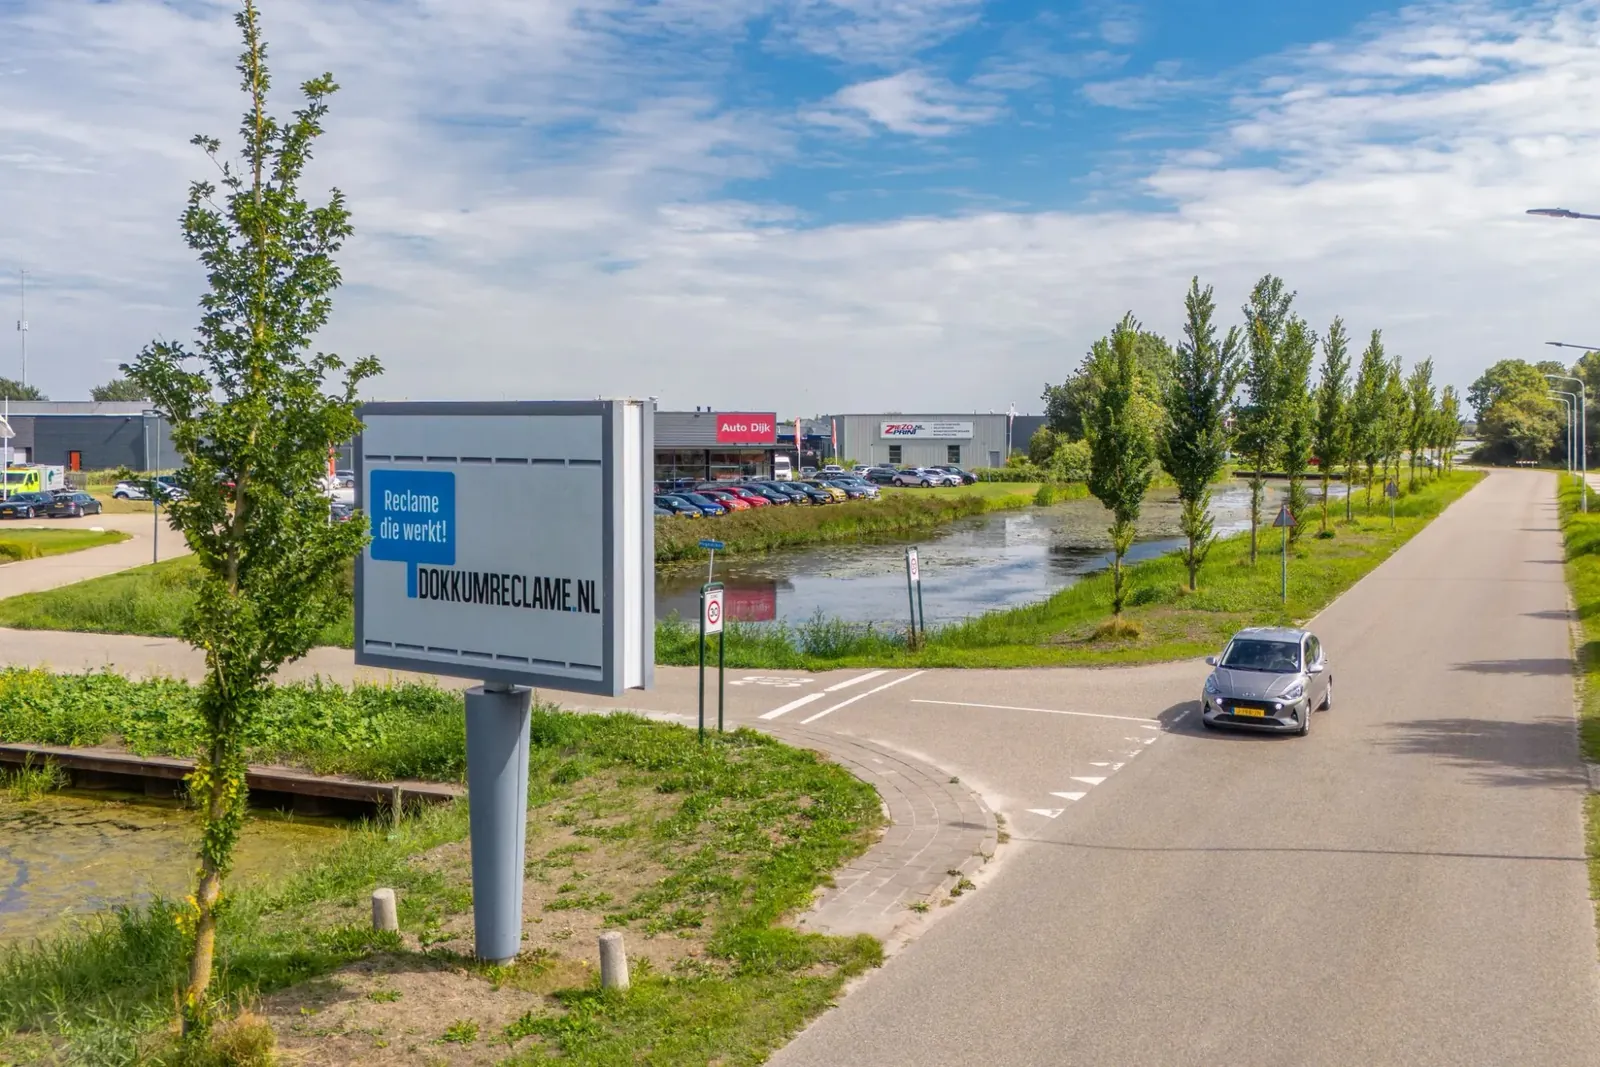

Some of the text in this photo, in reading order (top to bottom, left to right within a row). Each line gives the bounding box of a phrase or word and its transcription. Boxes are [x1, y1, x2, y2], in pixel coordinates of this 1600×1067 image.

[721, 422, 771, 434] Auto Dijk
[384, 489, 439, 513] Reclame
[380, 516, 447, 543] die werkt!
[419, 568, 600, 614] DOKKUMRECLAME.NL
[710, 607, 718, 617] 30
